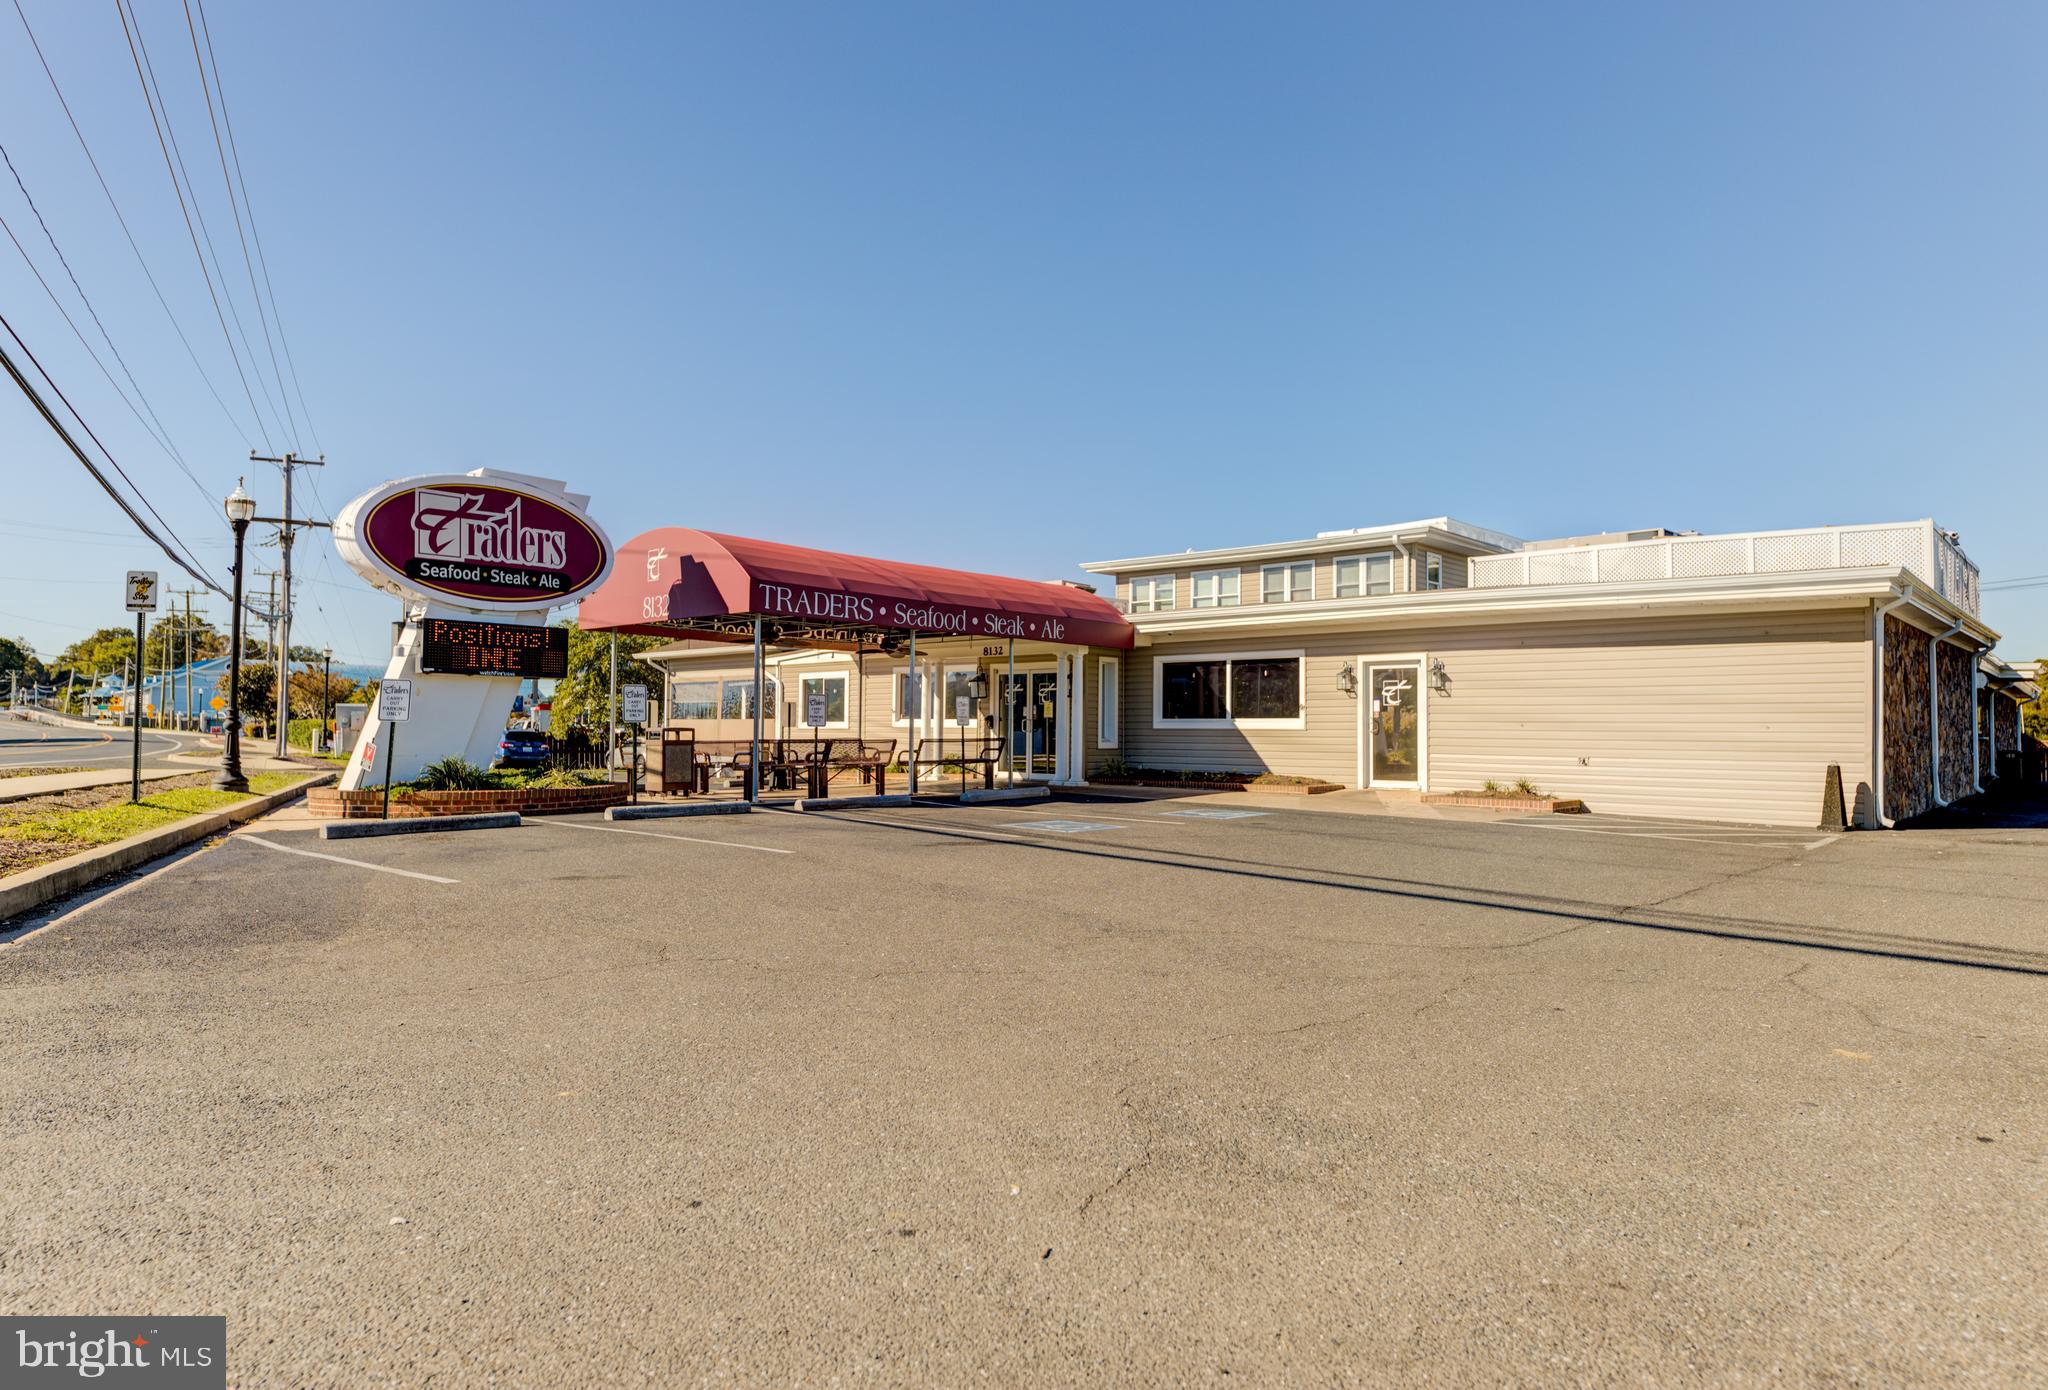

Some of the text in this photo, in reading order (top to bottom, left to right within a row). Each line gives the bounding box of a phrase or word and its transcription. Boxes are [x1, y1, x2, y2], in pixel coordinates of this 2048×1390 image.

[411, 488, 566, 569] Traders
[129, 576, 154, 588] Trolley
[420, 562, 560, 589] Seafood Steak Ale
[132, 591, 149, 603] Stop
[642, 593, 670, 619] 8132
[759, 583, 1065, 640] TRADERS Seafood Steak Ale
[434, 621, 550, 648] Positions!
[983, 646, 1004, 656] 8132
